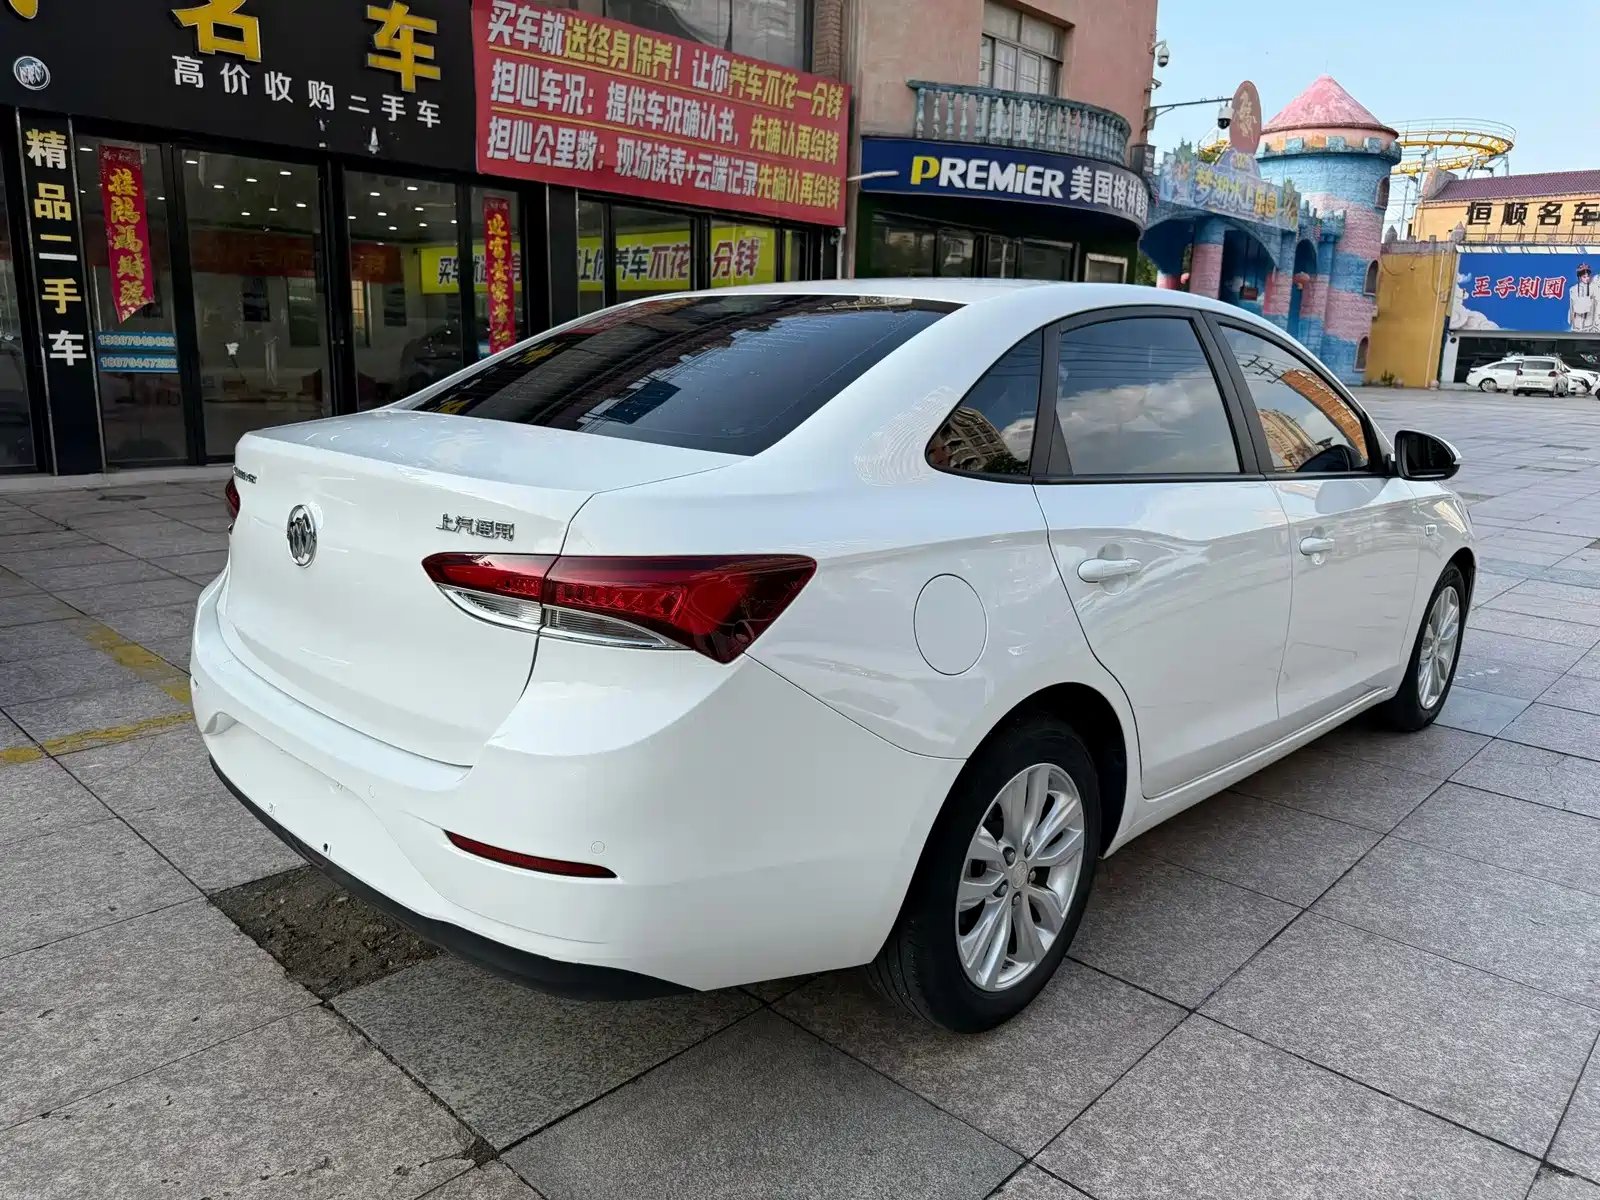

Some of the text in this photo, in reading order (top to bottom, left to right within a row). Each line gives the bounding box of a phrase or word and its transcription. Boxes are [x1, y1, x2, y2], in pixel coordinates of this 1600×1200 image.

[171, 55, 441, 128] 高价收购二手车
[1466, 201, 1600, 226] 恒顺名车
[26, 128, 87, 367] 精品二手车
[436, 513, 515, 541] 上汽通用
